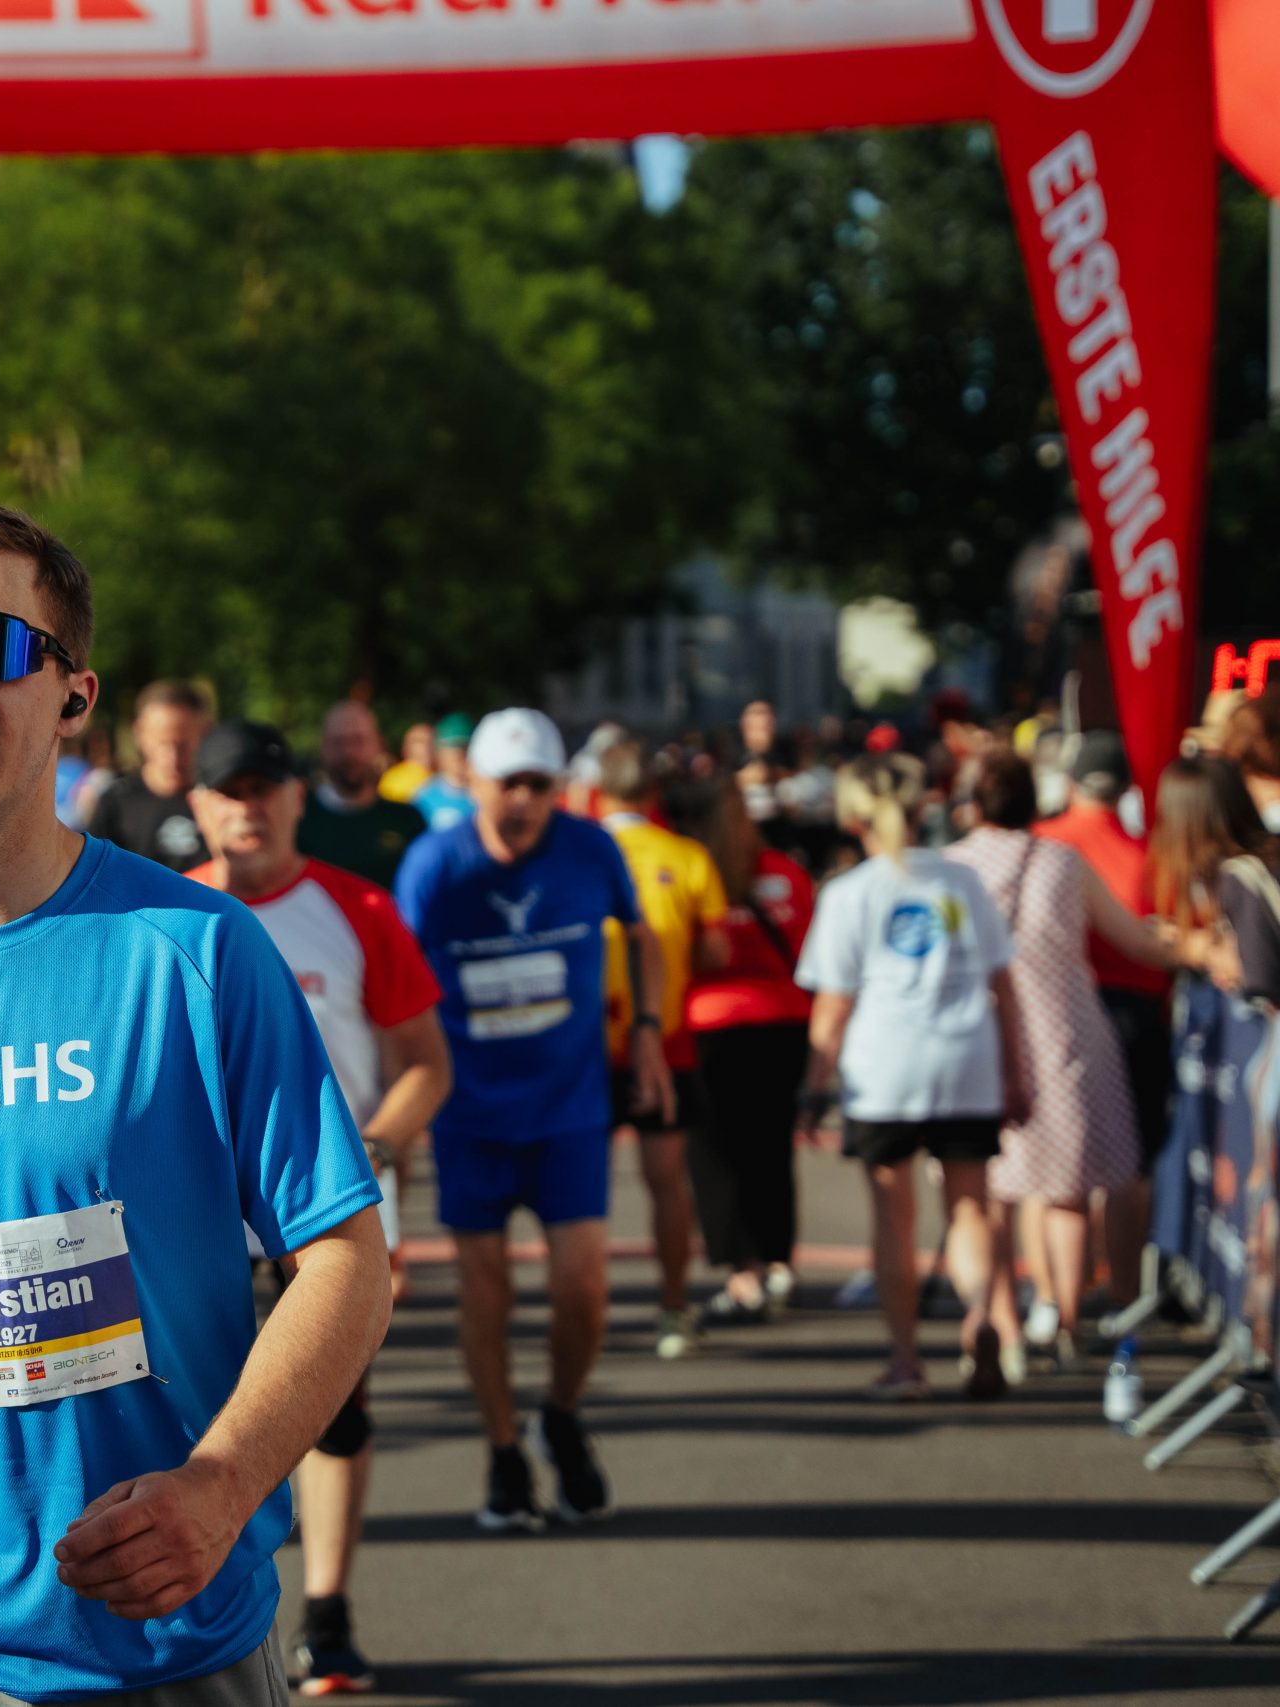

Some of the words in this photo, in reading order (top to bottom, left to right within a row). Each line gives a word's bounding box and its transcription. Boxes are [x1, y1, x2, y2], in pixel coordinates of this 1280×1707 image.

[1028, 129, 1142, 424] ERSTE
[1091, 406, 1183, 671] HILFE
[30, 1346, 43, 1356] UHR
[53, 1348, 116, 1371] BIONTECH
